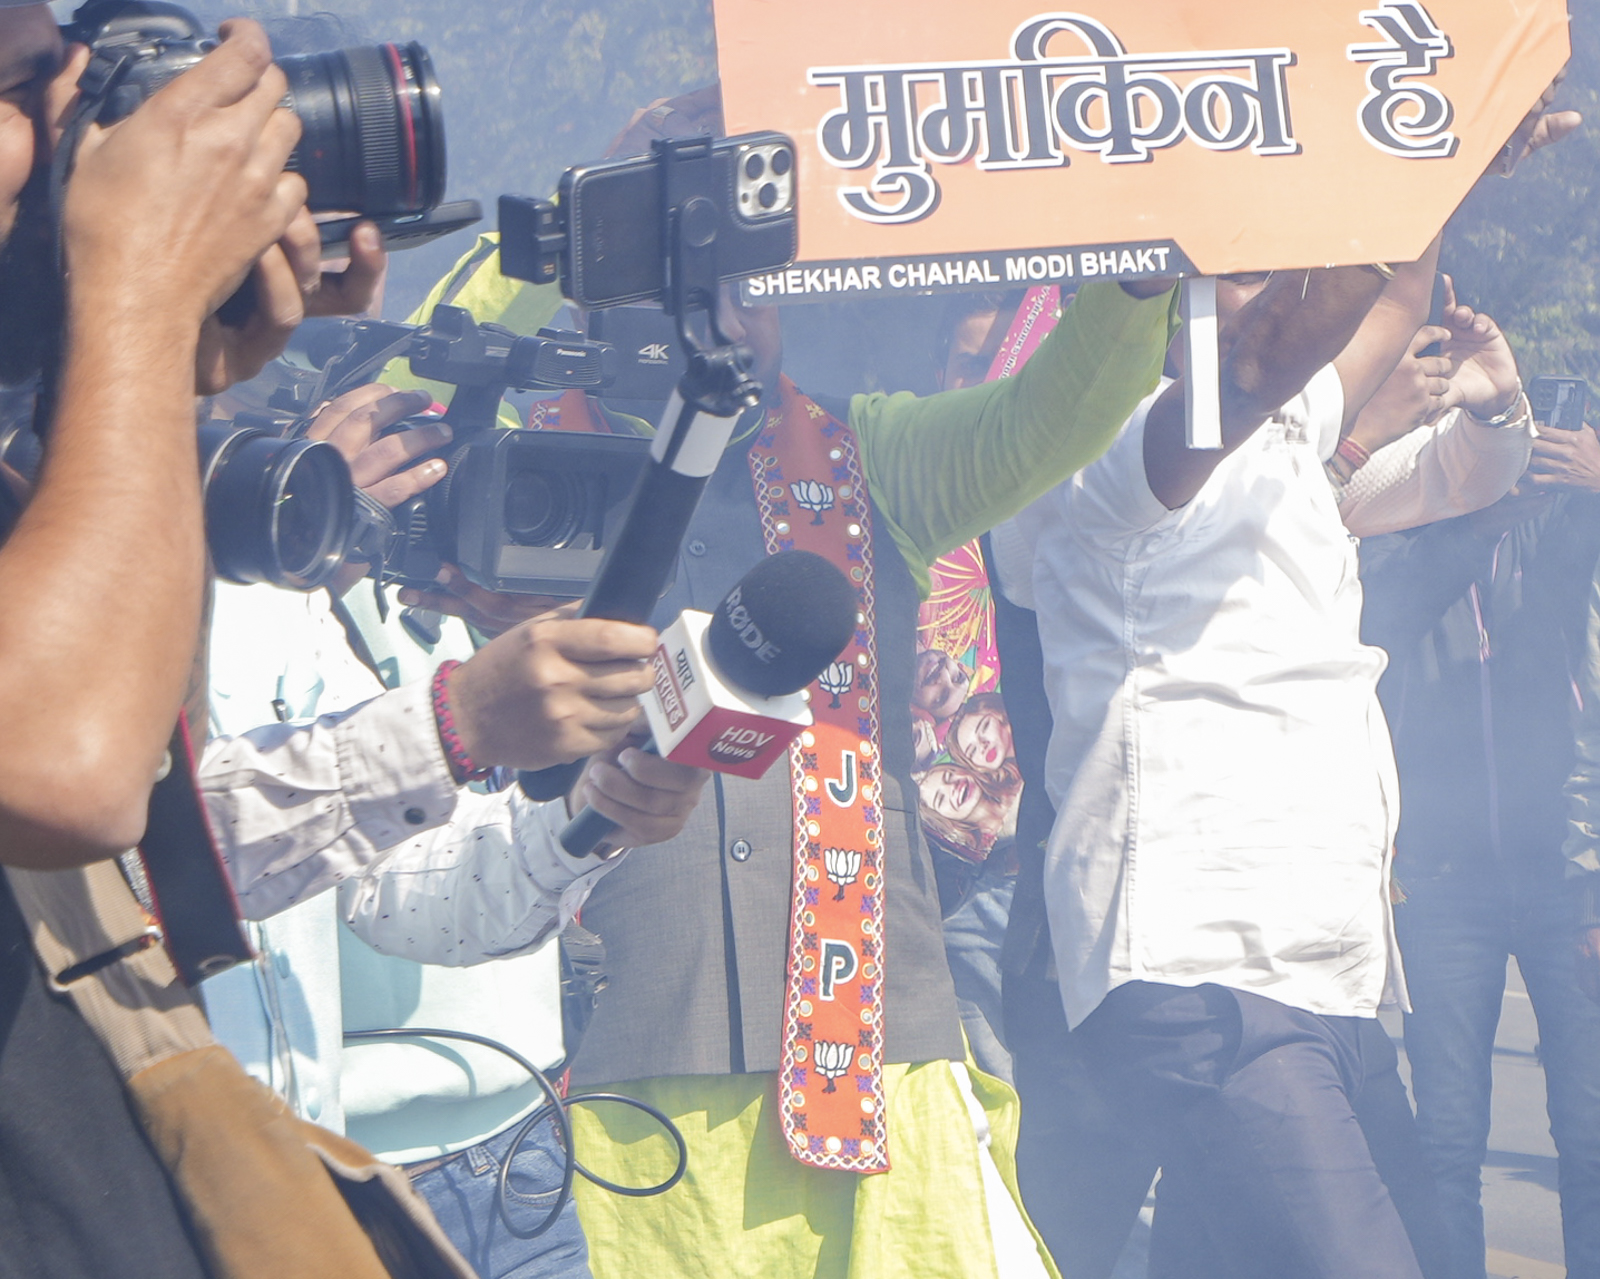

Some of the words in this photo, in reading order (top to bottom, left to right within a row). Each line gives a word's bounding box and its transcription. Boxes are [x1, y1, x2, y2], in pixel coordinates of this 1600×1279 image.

[806, 11, 1302, 224] मुमकिन
[748, 264, 882, 297] SHEKHAR
[888, 258, 1000, 288] CHAHAL
[1005, 252, 1079, 282] MODI
[1081, 246, 1171, 276] BHAKT
[638, 343, 670, 360] 4K
[711, 742, 756, 760] News
[719, 725, 776, 748] HDV
[824, 750, 859, 808] J
[819, 938, 859, 1002] P
